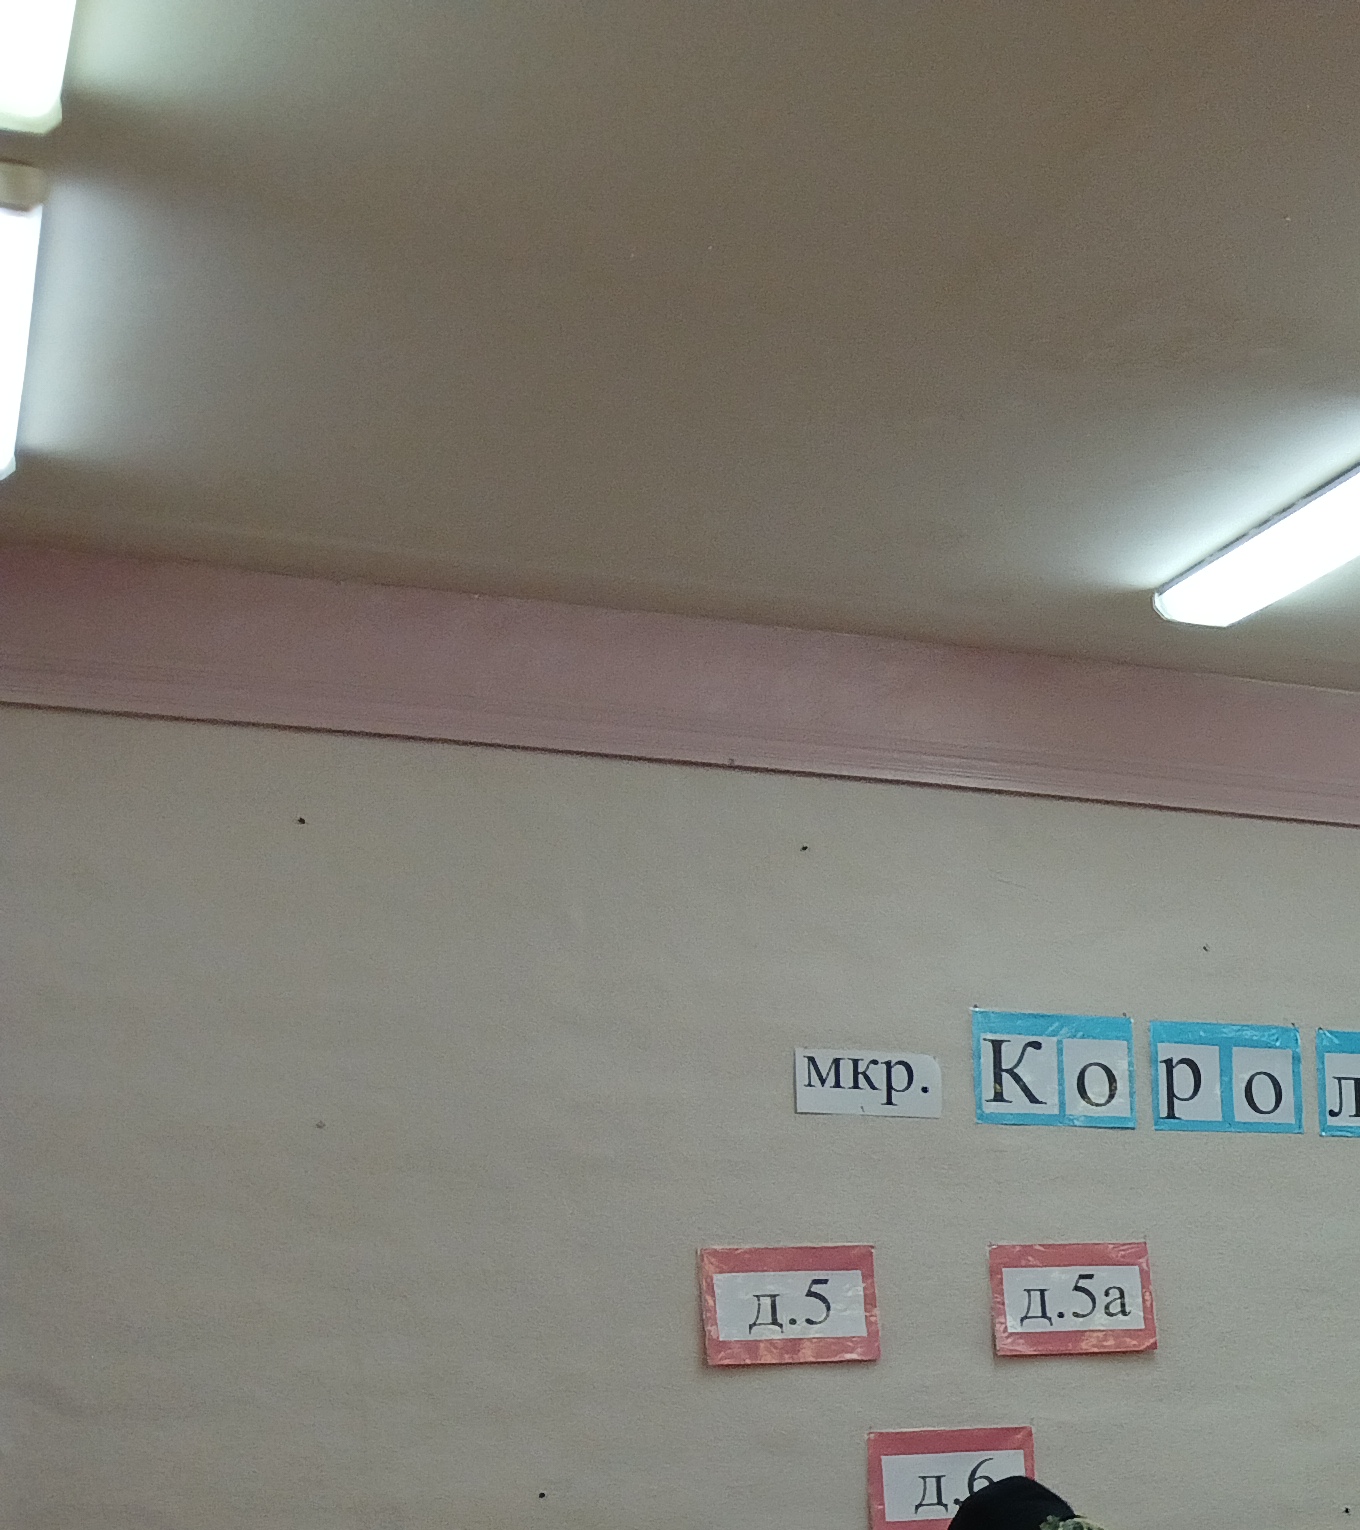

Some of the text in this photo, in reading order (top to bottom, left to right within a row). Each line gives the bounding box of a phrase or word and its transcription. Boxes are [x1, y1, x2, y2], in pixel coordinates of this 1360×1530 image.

[803, 1056, 930, 1106] мкр.
[748, 1278, 832, 1334] д.5
[1019, 1272, 1132, 1325] д.5а
